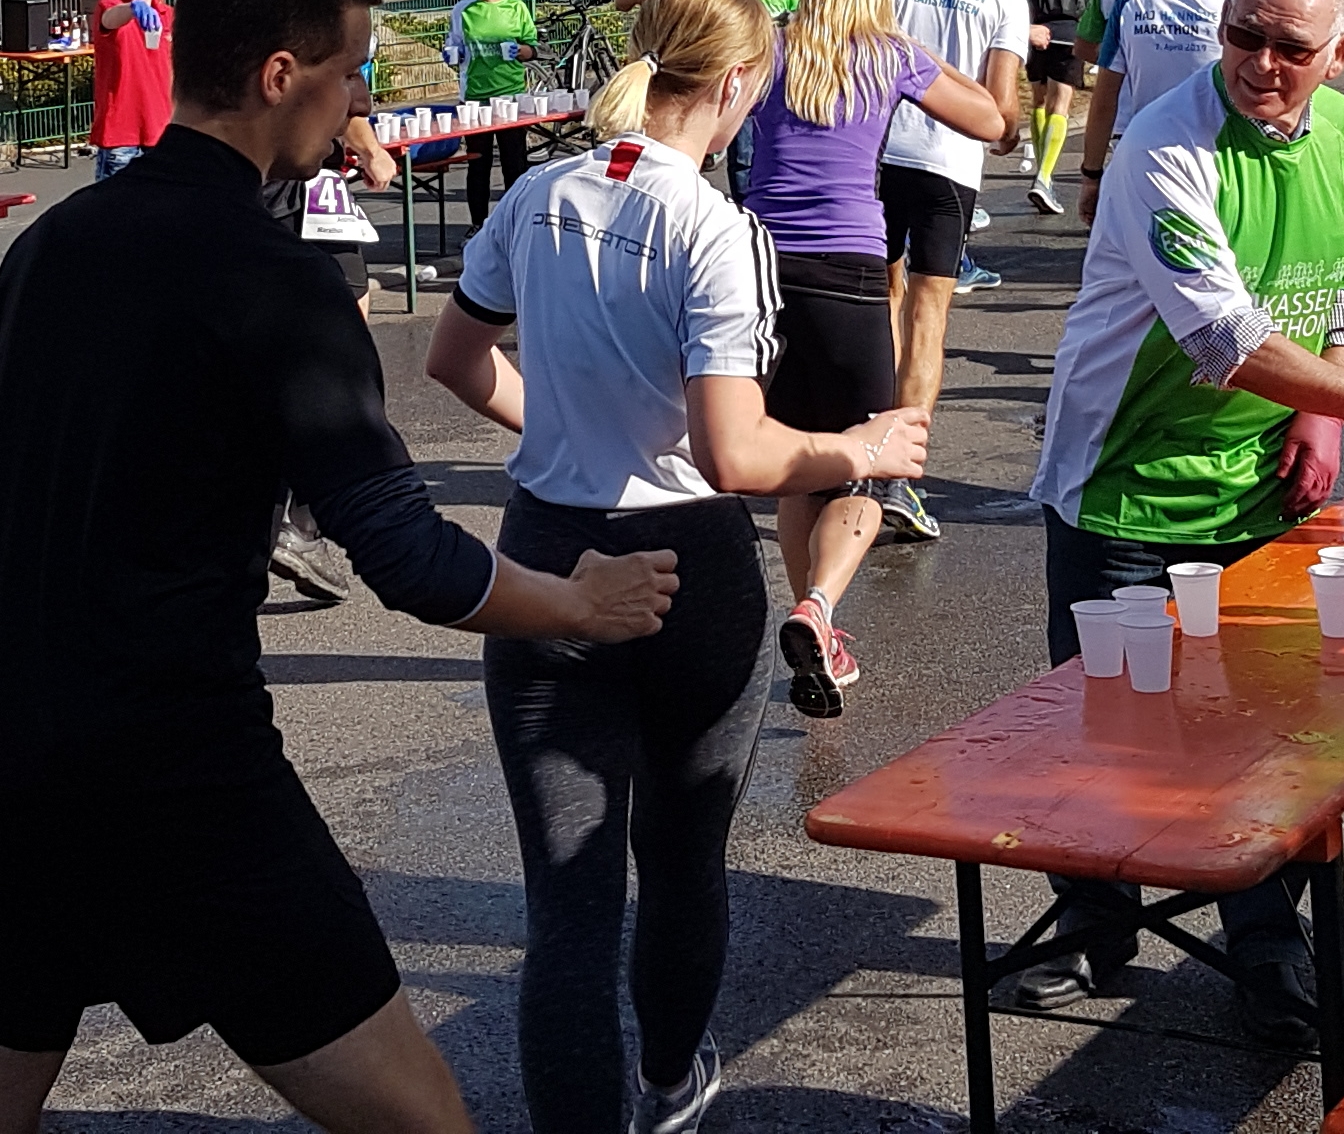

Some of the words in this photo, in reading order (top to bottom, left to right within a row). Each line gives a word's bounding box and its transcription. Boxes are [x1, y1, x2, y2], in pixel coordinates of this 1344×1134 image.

[1134, 10, 1155, 21] HAJ
[1134, 24, 1199, 35] MARATHON
[1263, 287, 1334, 317] KASSEL
